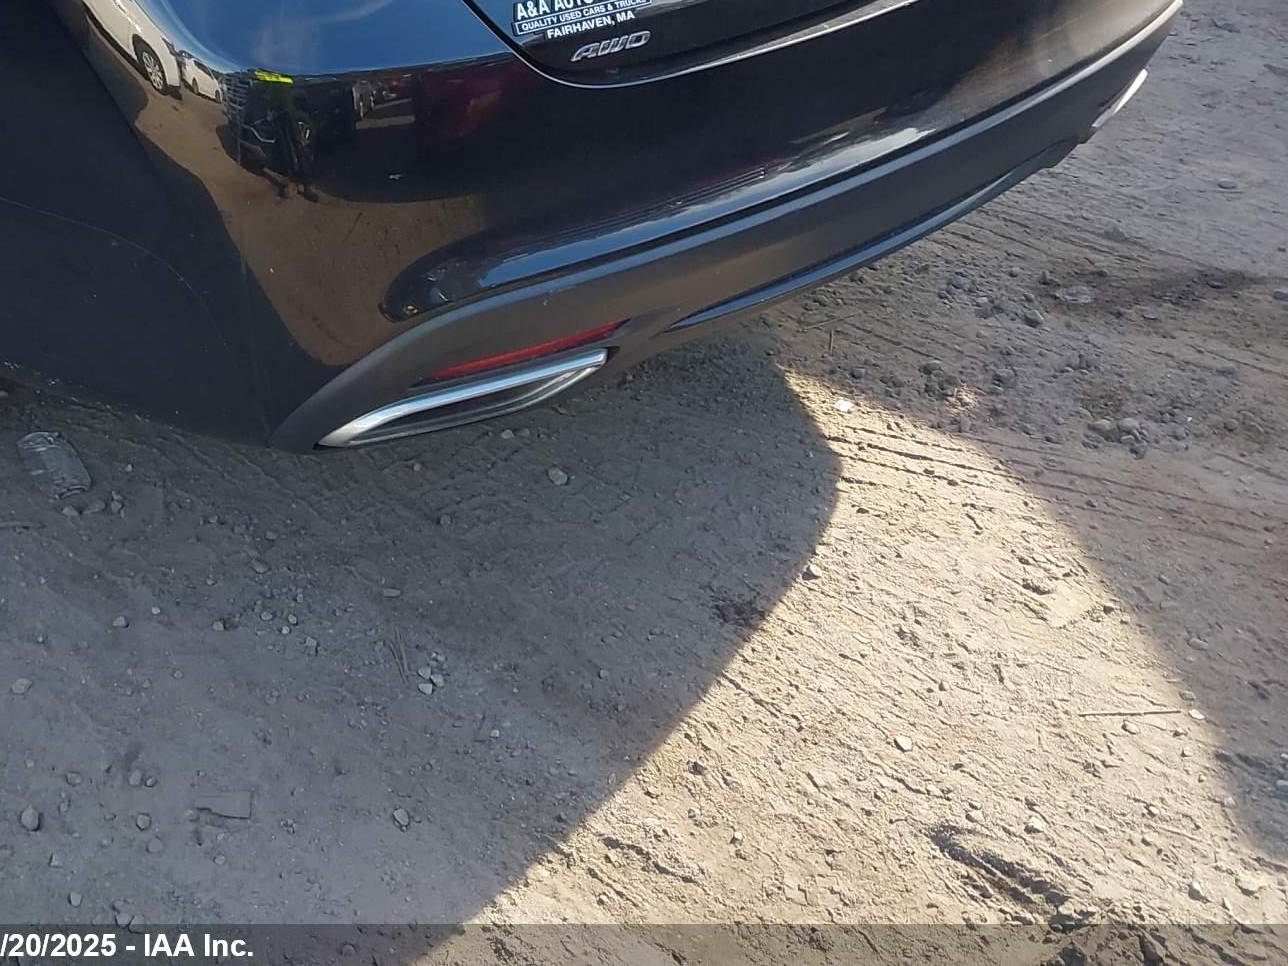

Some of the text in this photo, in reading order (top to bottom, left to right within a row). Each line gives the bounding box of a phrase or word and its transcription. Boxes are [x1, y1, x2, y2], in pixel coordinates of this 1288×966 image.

[521, 16, 558, 31] QUALITY
[559, 10, 582, 22] USED
[583, 4, 606, 17] CARS
[547, 11, 635, 40] FAIRHAVEN, MA
[569, 30, 652, 62] AWD
